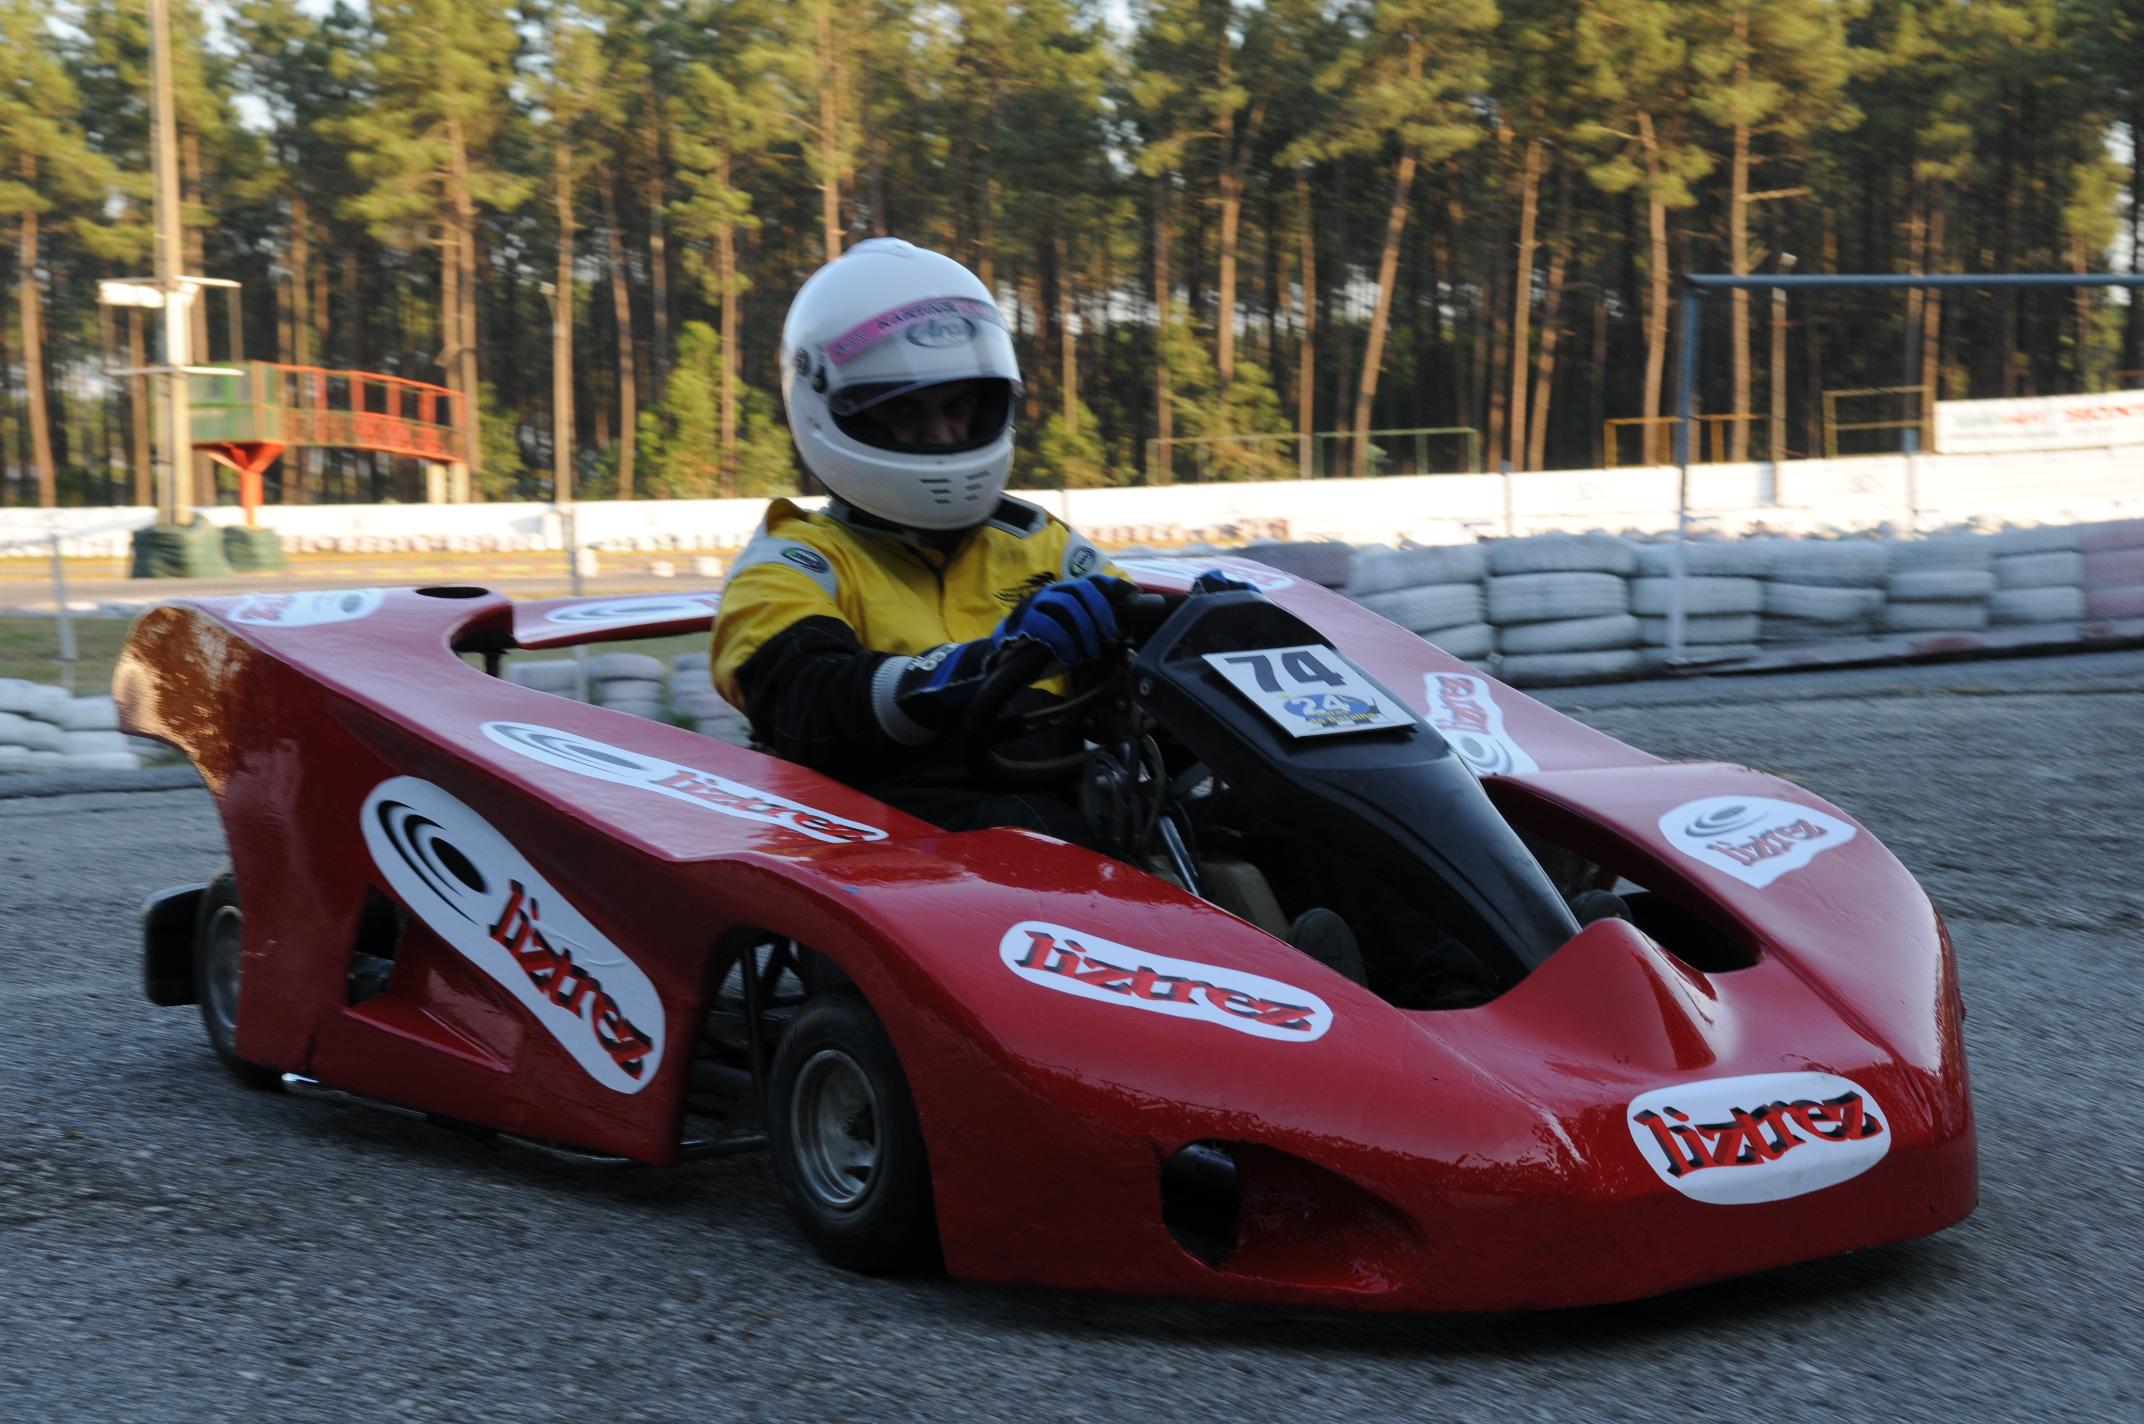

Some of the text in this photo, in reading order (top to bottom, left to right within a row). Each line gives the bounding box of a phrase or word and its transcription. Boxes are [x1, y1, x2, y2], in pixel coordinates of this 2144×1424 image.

[1224, 649, 1348, 693] 74
[1290, 694, 1352, 716] 24
[649, 769, 878, 842] liztrez
[488, 878, 654, 1081] liztrez
[1013, 930, 1317, 1033] liztrez
[1633, 1090, 1884, 1178] liztrez
